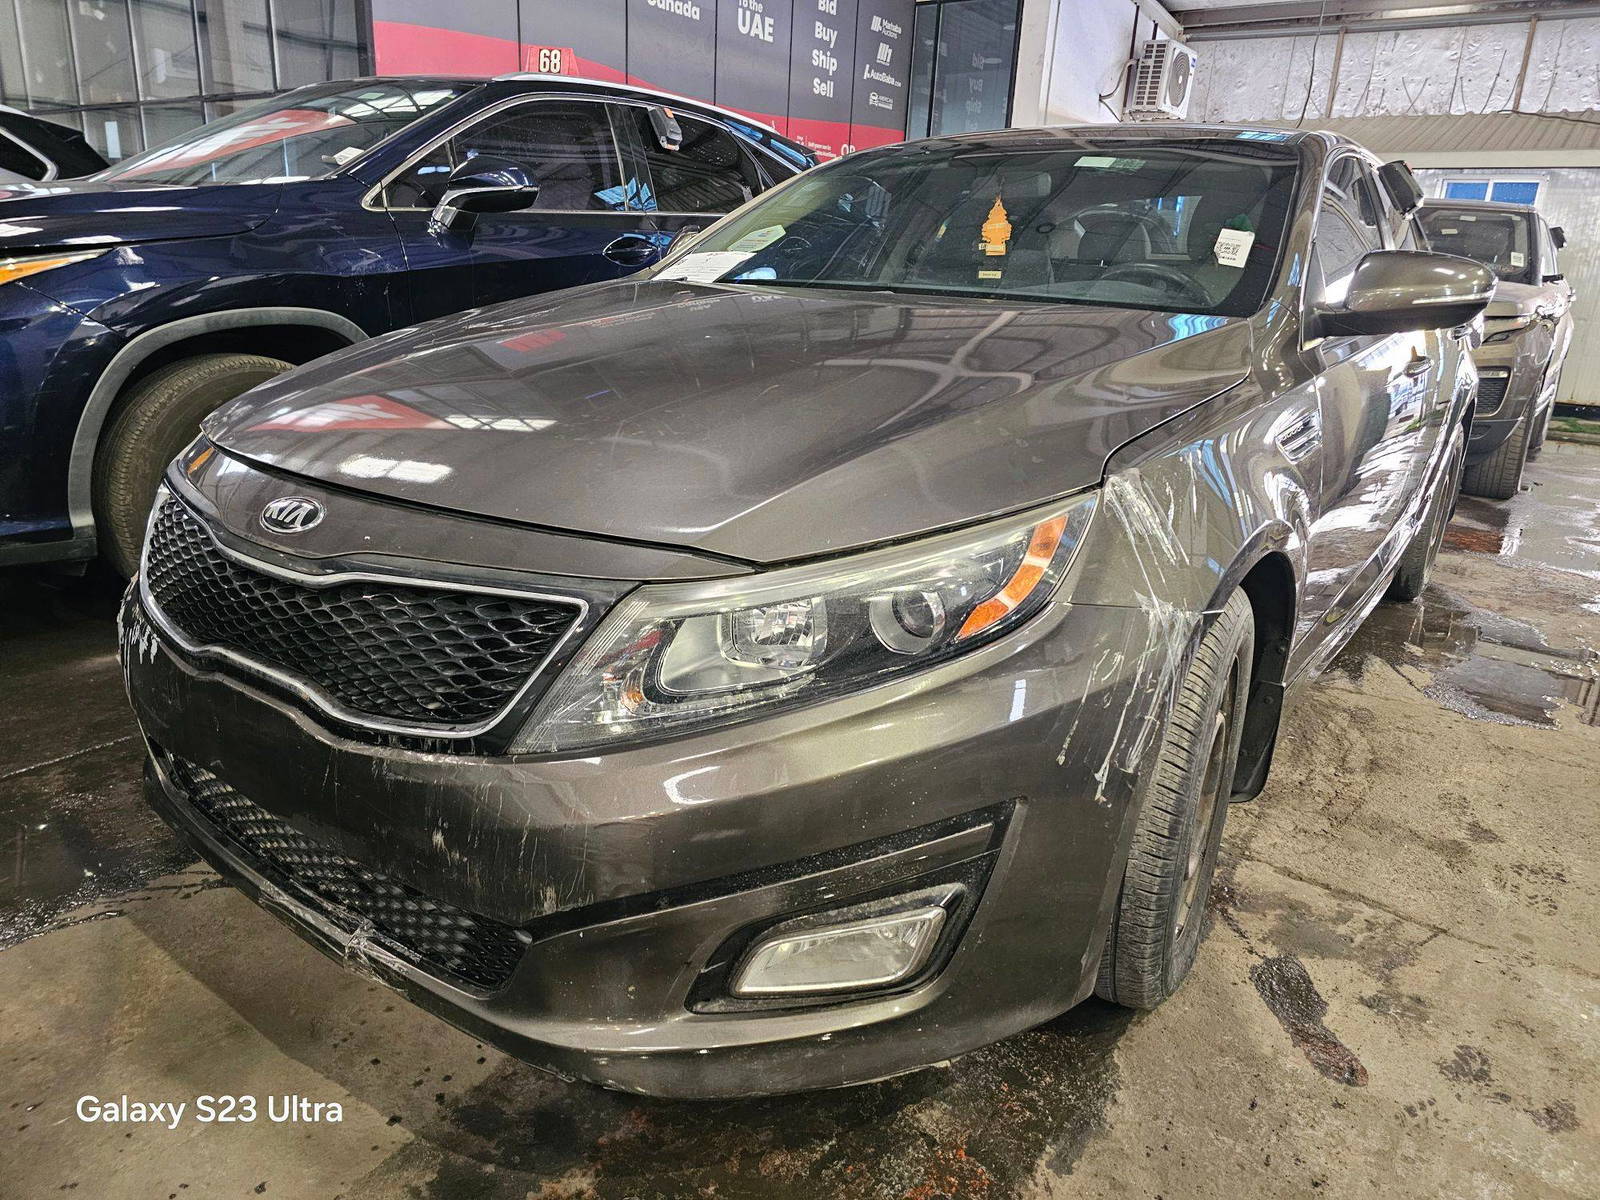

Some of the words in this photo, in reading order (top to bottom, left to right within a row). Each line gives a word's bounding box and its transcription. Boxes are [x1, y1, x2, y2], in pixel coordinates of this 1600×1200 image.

[749, 0, 764, 13] the
[818, 0, 837, 16] Bid
[737, 7, 774, 43] UAE
[815, 21, 838, 49] Buy
[540, 48, 561, 74] 68
[811, 49, 838, 75] Ship
[813, 77, 834, 98] Sell
[265, 500, 314, 529] KIA
